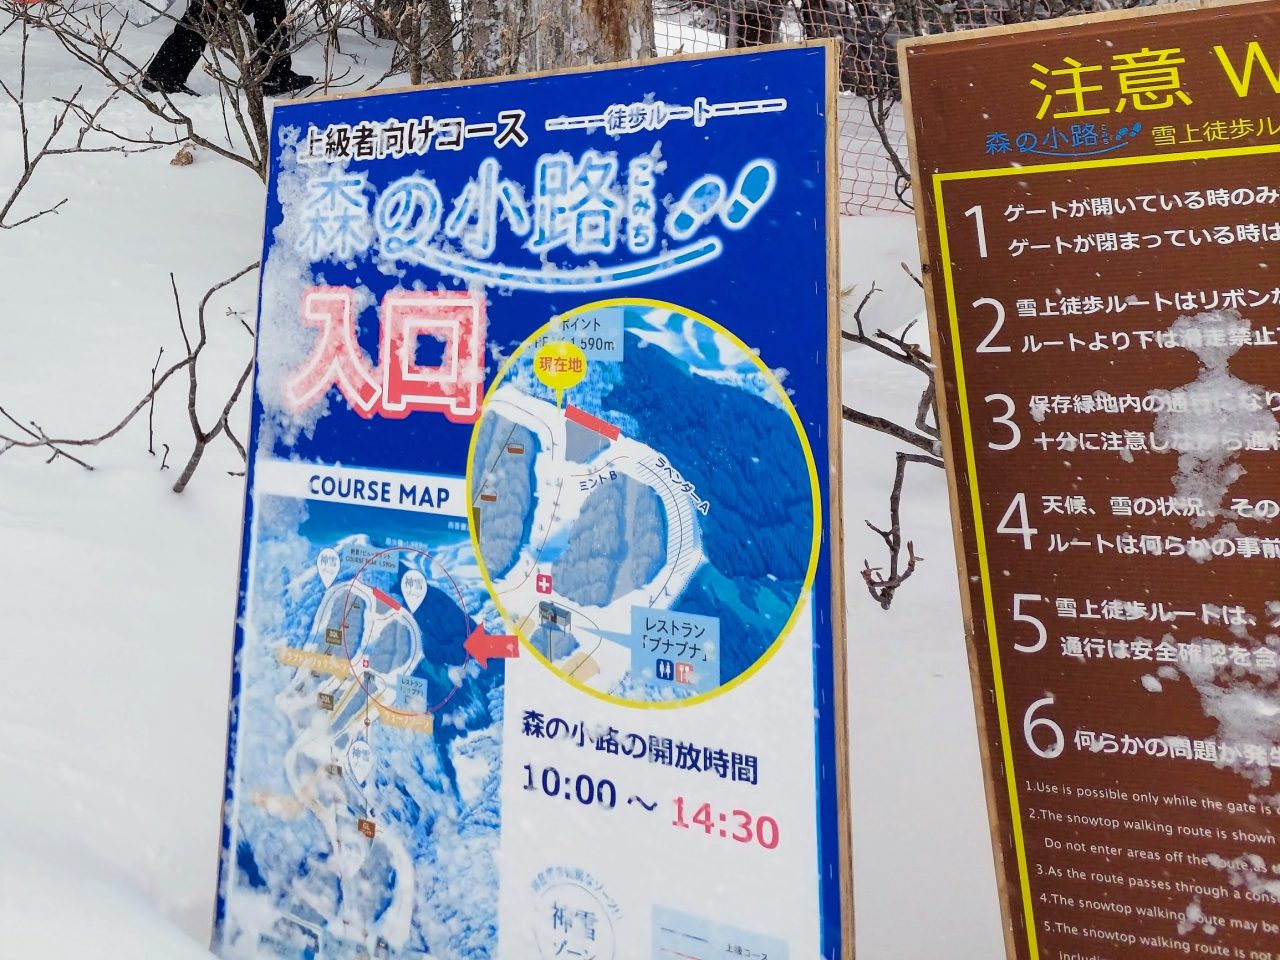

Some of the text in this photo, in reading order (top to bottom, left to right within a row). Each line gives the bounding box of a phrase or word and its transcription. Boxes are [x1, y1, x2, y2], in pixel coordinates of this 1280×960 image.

[1029, 47, 1194, 121] 注意
[298, 111, 527, 160] 上級者向けコース
[986, 122, 1099, 156] 森の小路
[1151, 116, 1280, 147] 雪上徒歩ル
[295, 155, 618, 256] 森の小路
[964, 185, 1280, 258] 1 ゲートが開いている時のみ
[1008, 221, 1280, 257] ゲートが閉まっている時は
[972, 297, 1012, 353] 2
[1021, 325, 1280, 353] ルートより下は滑走禁止
[285, 286, 487, 424] 入口
[539, 356, 583, 373] 現在地
[984, 393, 1022, 451] 3
[309, 475, 450, 509] COURSE MAP
[655, 456, 710, 514] ラベンダーA
[996, 492, 1038, 550] 4
[645, 617, 706, 638] レストラン
[1013, 593, 1048, 653] 5
[521, 709, 759, 786] 森の小路の開放時間
[1023, 697, 1065, 759] 6
[523, 763, 617, 810] 10:00
[671, 796, 780, 850] 14:30
[1025, 780, 1058, 794] 1.Use
[1062, 784, 1072, 795] is
[1076, 787, 1128, 800] possible
[1132, 791, 1159, 806] only
[1163, 794, 1197, 807] while
[1201, 798, 1223, 810] the
[1227, 802, 1256, 814] gate
[1261, 803, 1272, 815] is
[1028, 808, 1276, 844] 2.The snowtop walking route is shown
[1044, 837, 1062, 849] Do
[1066, 842, 1086, 853] not
[1090, 844, 1122, 856] enter
[1126, 849, 1161, 861] areas
[1165, 851, 1183, 863] off
[1187, 854, 1209, 866] the
[1035, 863, 1063, 877] 3.As
[1066, 868, 1087, 880] the
[1091, 872, 1124, 884] route
[1128, 877, 1171, 891] passes
[1175, 881, 1229, 899] through
[1233, 891, 1241, 899] a
[1039, 892, 1280, 934] 4.The snowtop walking oute may be
[1043, 920, 1079, 935] 5.The
[1083, 927, 1136, 945] snowtop
[1139, 936, 1191, 954] walking
[1195, 943, 1230, 956] route
[1235, 947, 1246, 959] is
[1250, 950, 1272, 960] not
